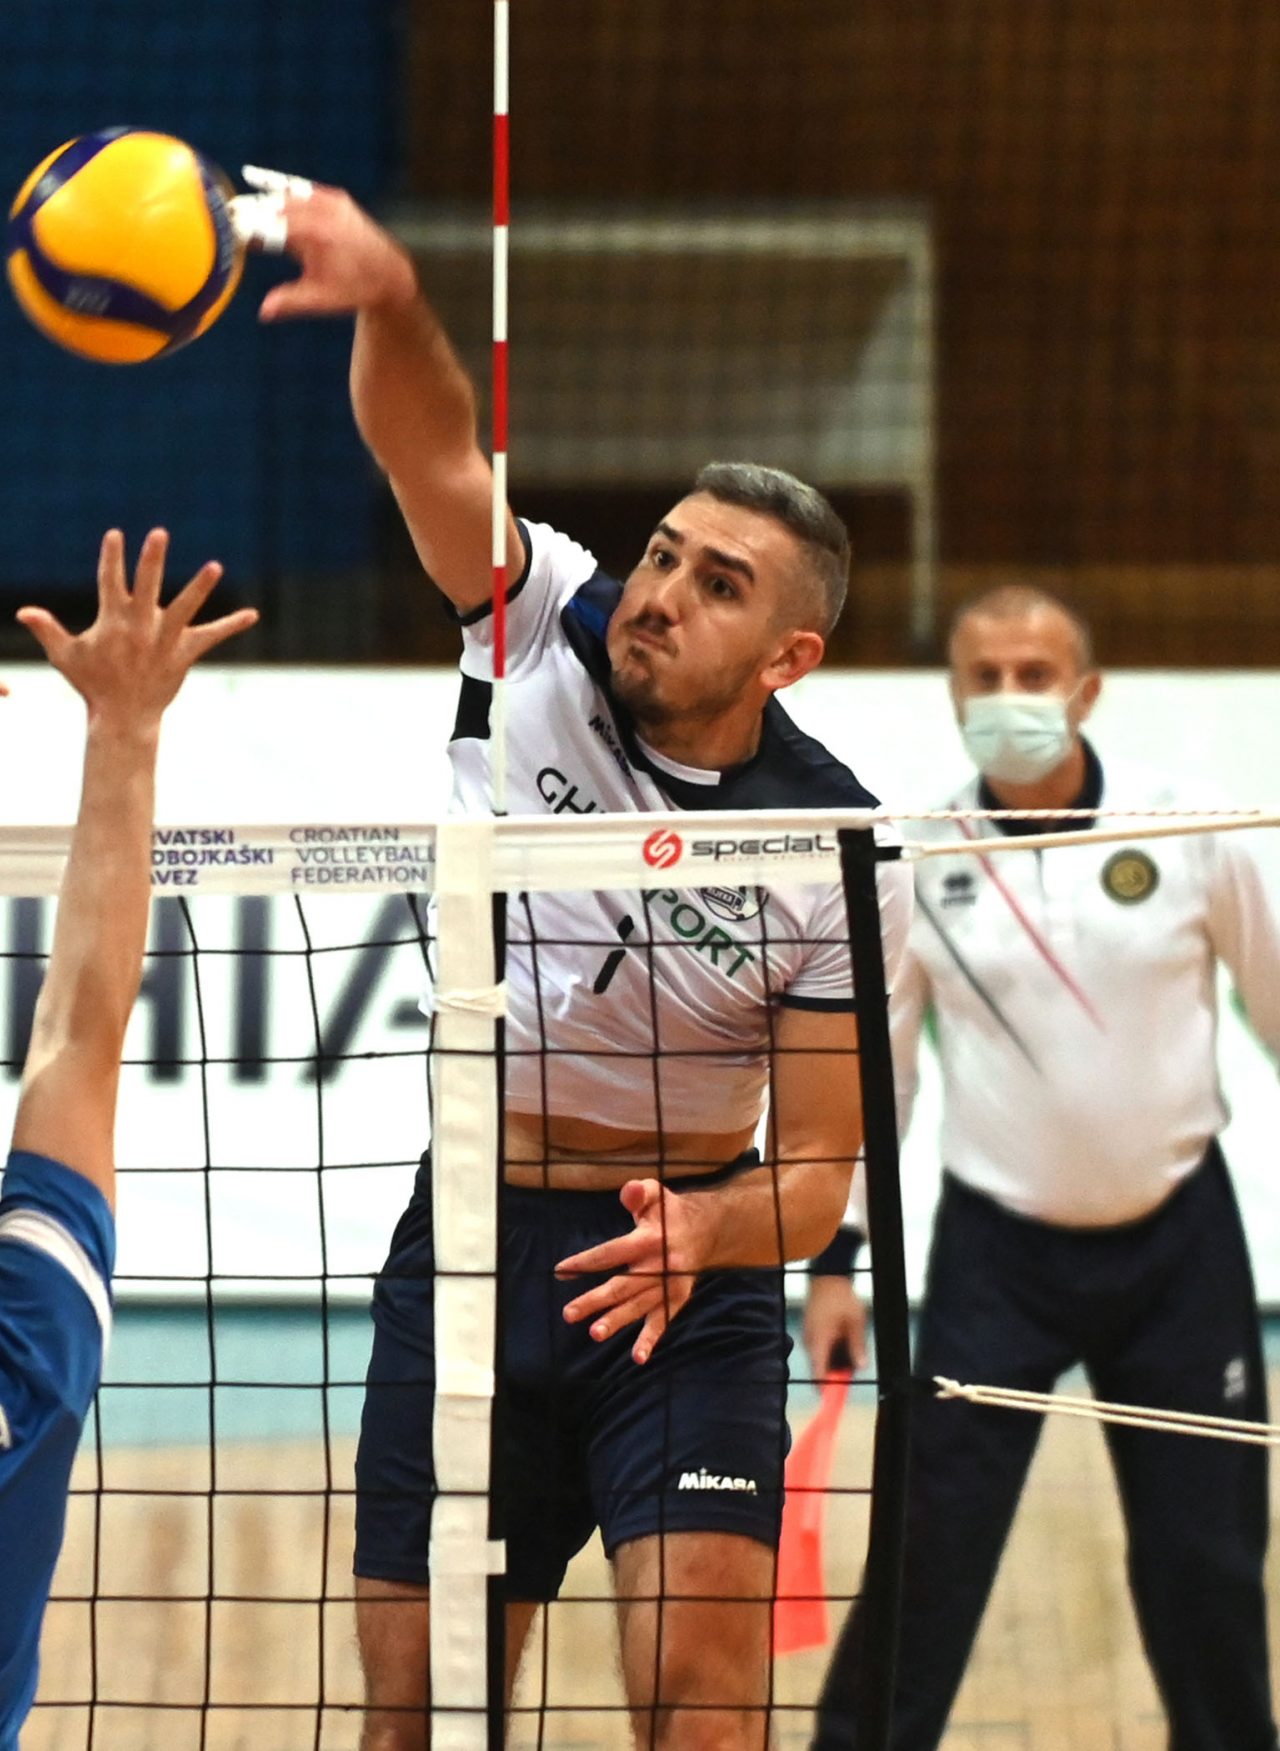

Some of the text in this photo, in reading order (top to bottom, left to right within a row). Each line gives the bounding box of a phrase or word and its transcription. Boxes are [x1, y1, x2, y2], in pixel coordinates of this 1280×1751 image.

[536, 766, 600, 814] GH
[153, 829, 235, 845] VATSKI
[289, 827, 399, 843] CROATIAN
[152, 845, 273, 865] DBOJKAŠKI
[296, 846, 435, 863] VOLLEYBALL
[151, 869, 198, 885] VEZ
[291, 866, 428, 884] FEDERATION
[644, 888, 755, 978] PORT
